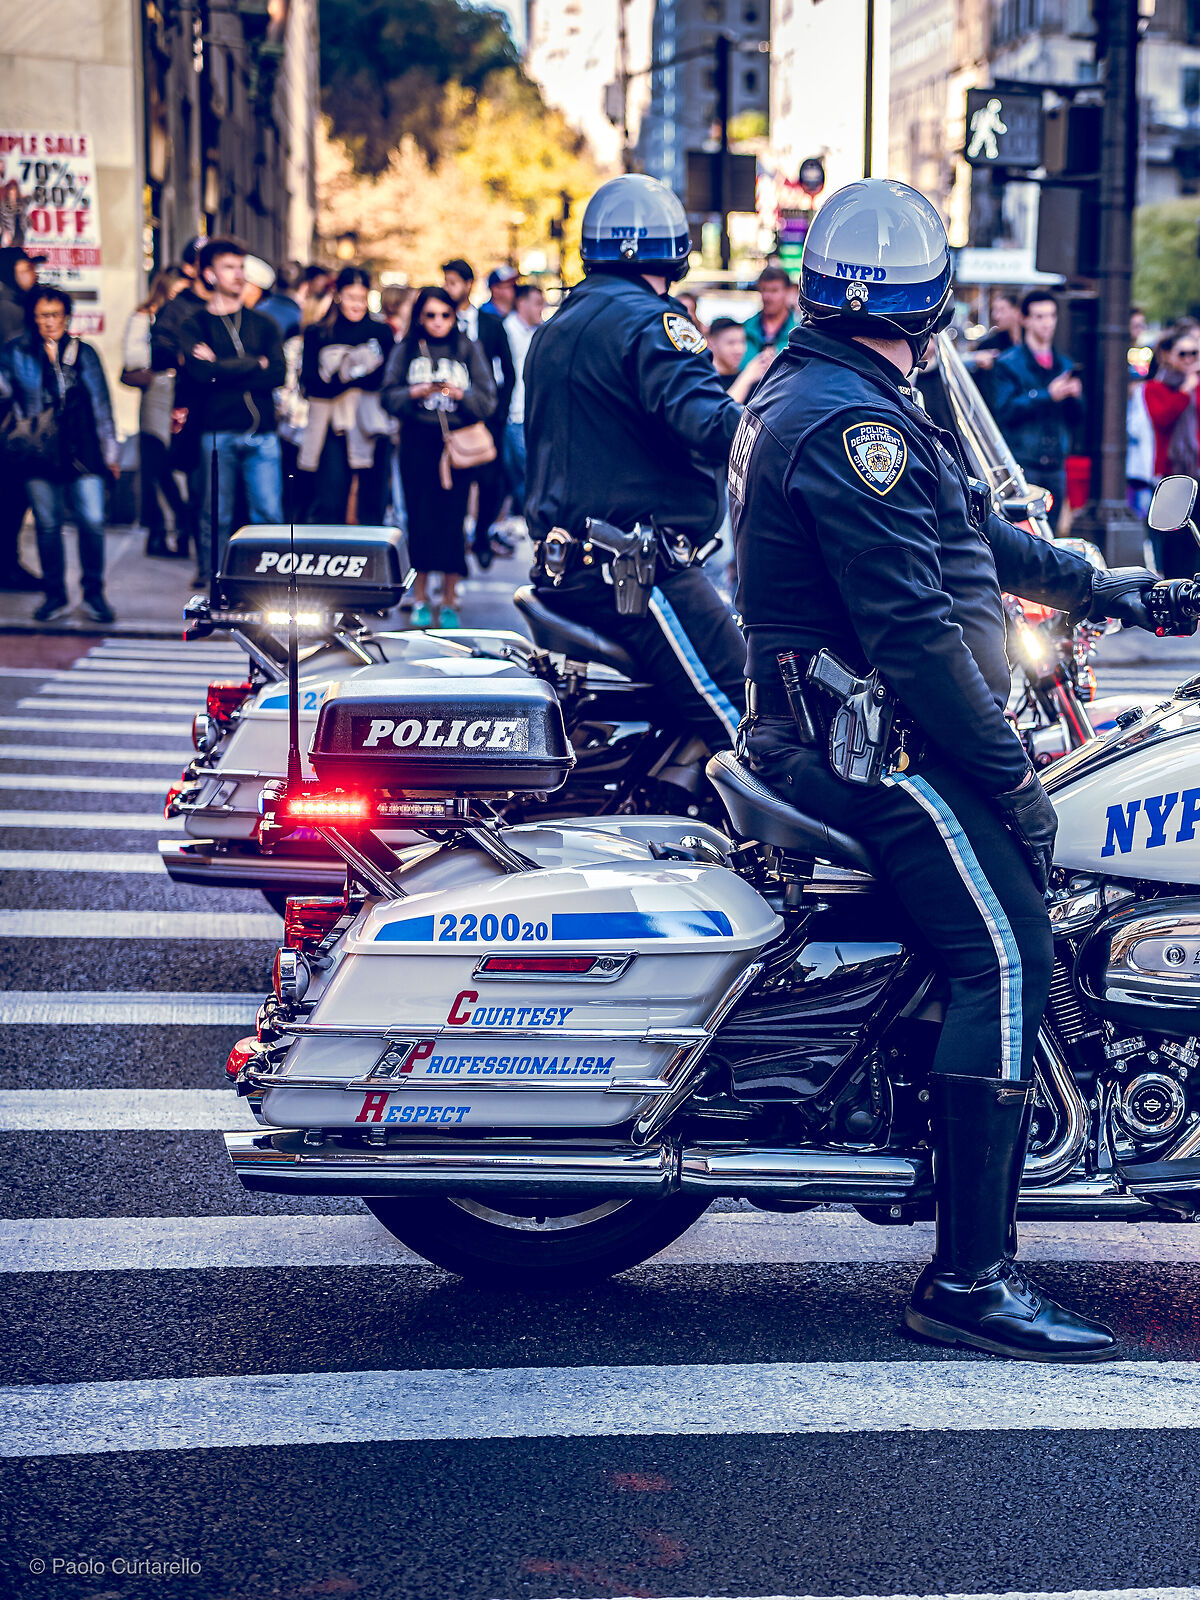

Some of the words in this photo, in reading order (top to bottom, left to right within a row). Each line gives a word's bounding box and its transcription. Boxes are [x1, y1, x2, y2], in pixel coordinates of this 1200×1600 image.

[45, 136, 87, 155] SALE
[19, 161, 74, 184] 70%
[31, 209, 89, 234] OFF
[836, 262, 887, 281] NYPD
[848, 288, 868, 298] DOT
[850, 433, 901, 448] DEPARTMENT
[860, 426, 890, 436] POLICE
[853, 455, 867, 472] CITY
[865, 472, 876, 482] OF
[884, 468, 897, 485] NEW
[894, 449, 903, 468] YORK
[255, 551, 368, 578] POLICE
[362, 719, 518, 748] POLICE
